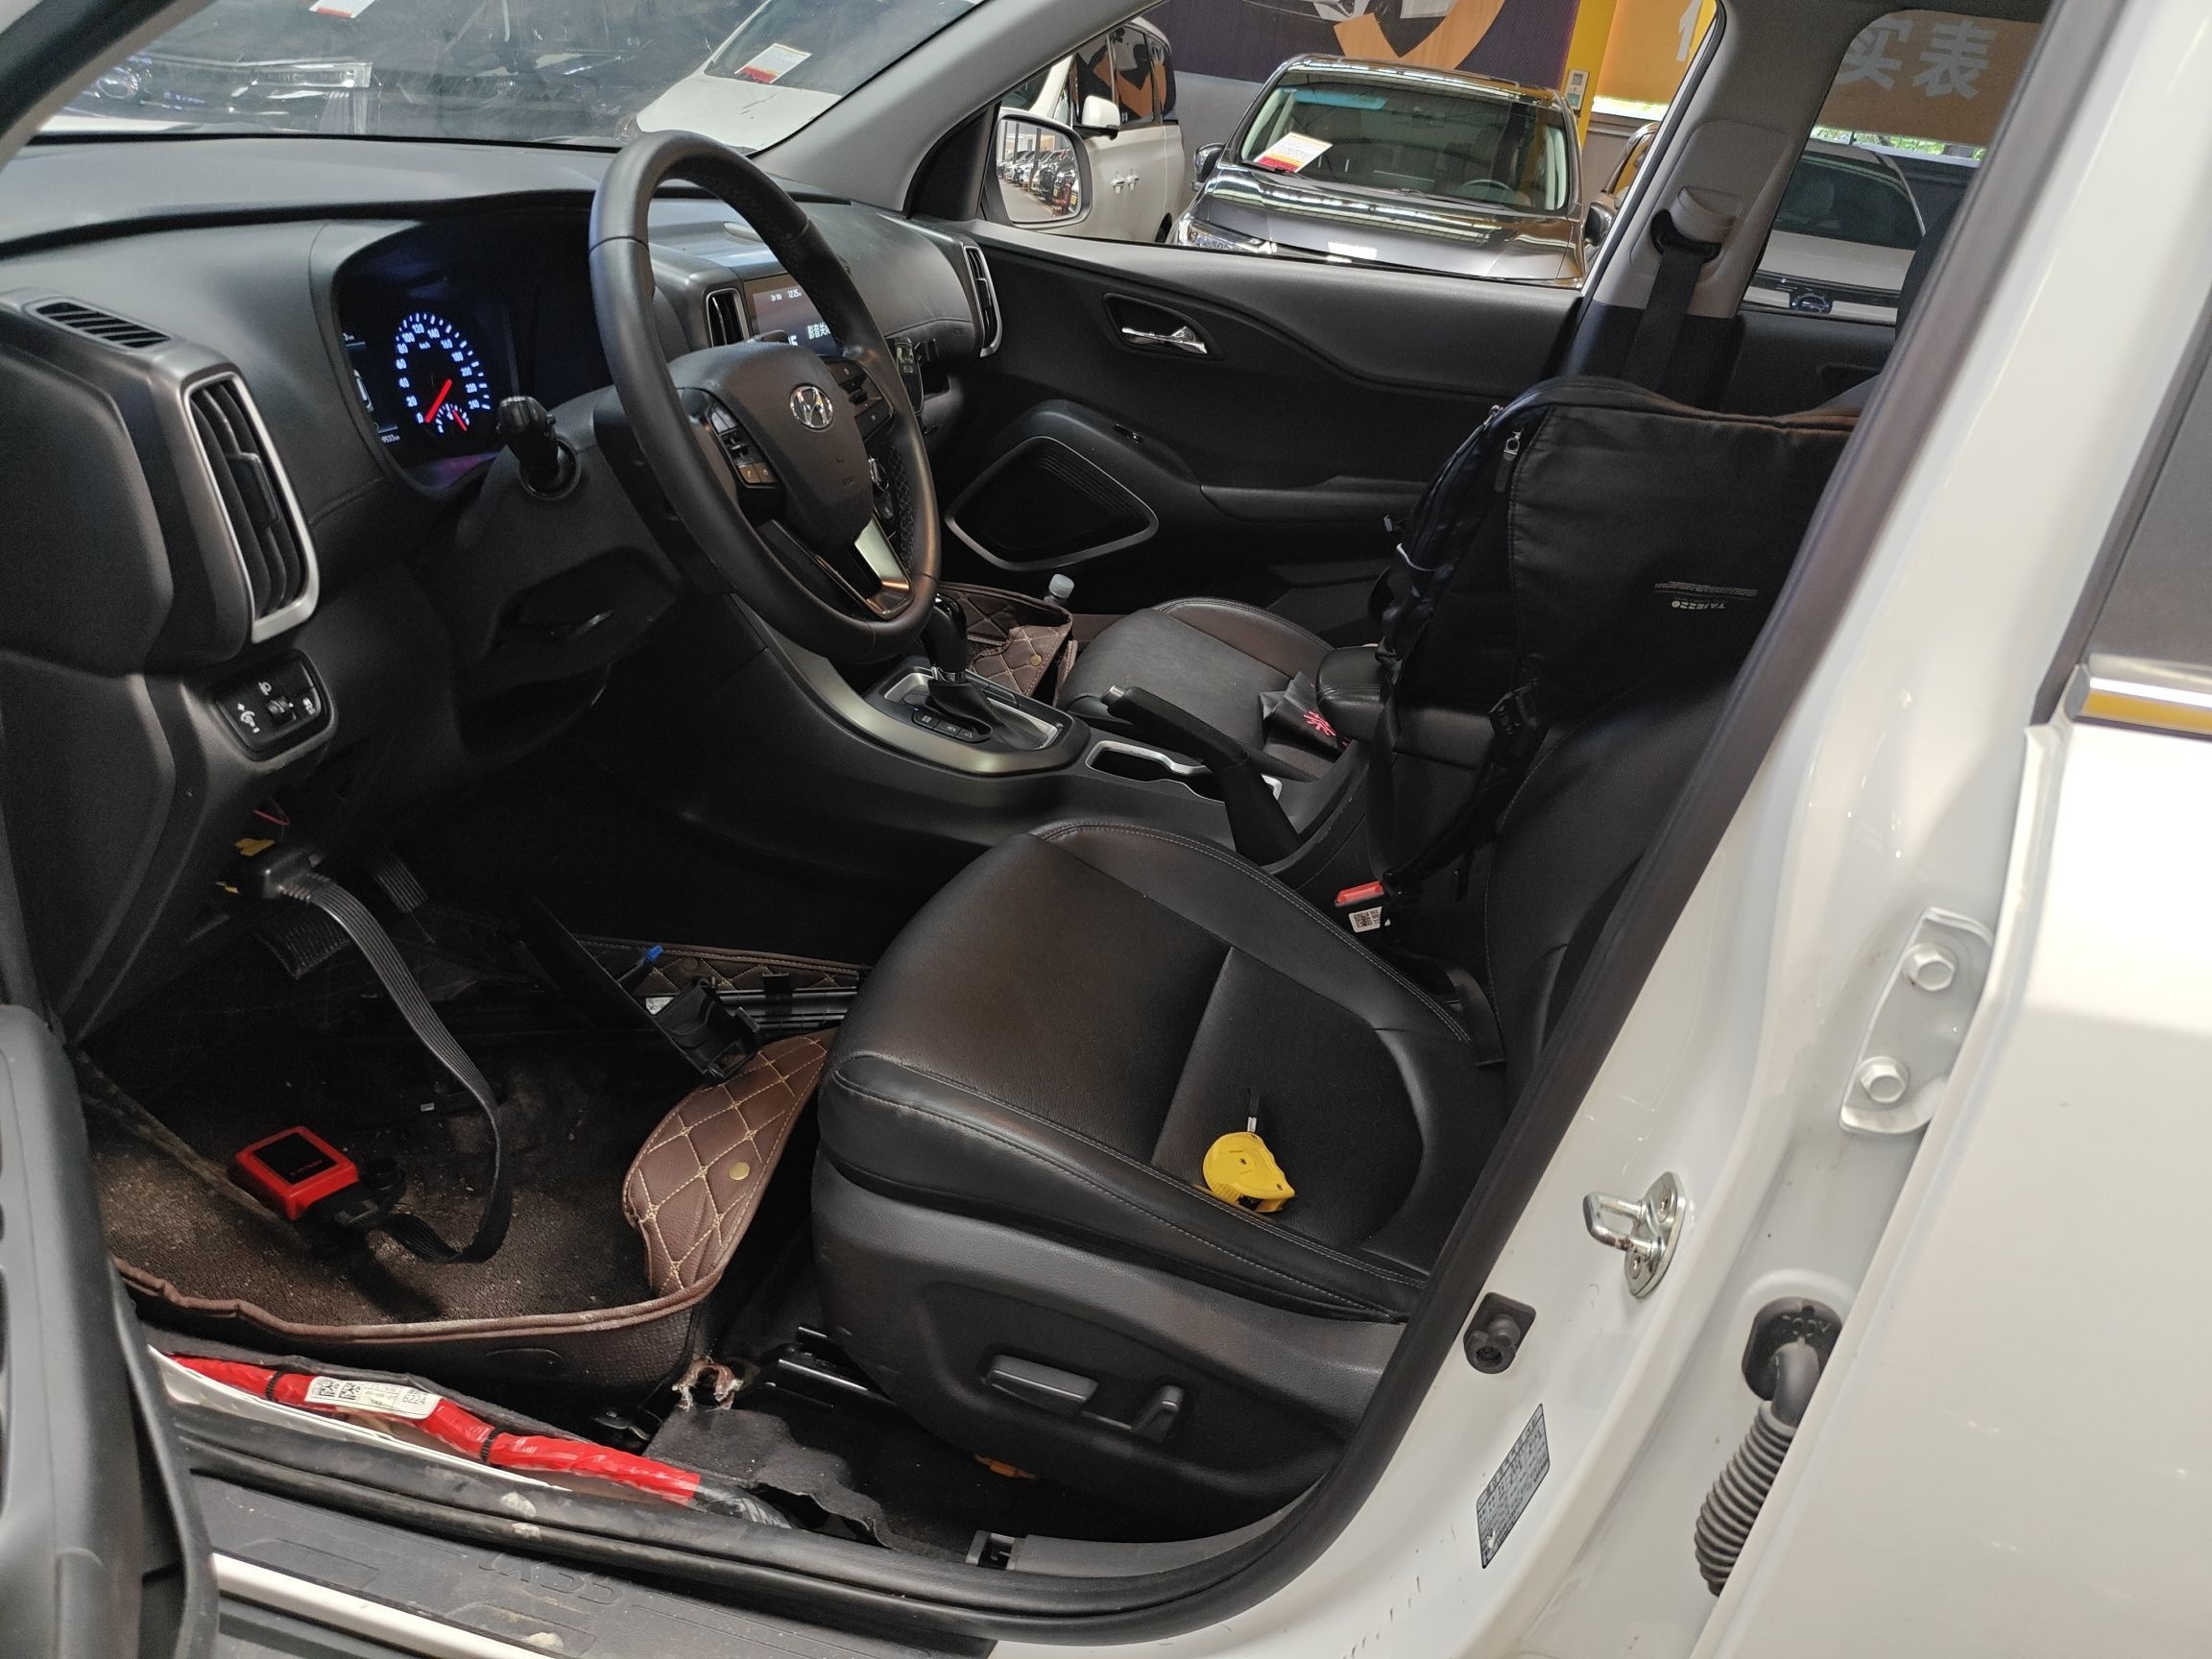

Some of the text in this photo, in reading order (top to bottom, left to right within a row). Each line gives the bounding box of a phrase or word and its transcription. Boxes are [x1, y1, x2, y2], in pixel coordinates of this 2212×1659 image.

[411, 323, 424, 334] 120
[427, 327, 441, 339] 140
[402, 332, 415, 343] 100
[441, 338, 453, 349] 160
[397, 343, 408, 354] 80
[451, 350, 464, 363] 180
[396, 358, 407, 370] 60
[460, 367, 472, 377] 200
[398, 376, 410, 389] 40
[465, 382, 477, 394] 220
[406, 395, 418, 407] 20
[468, 398, 480, 410] 240
[416, 412, 424, 423] 0
